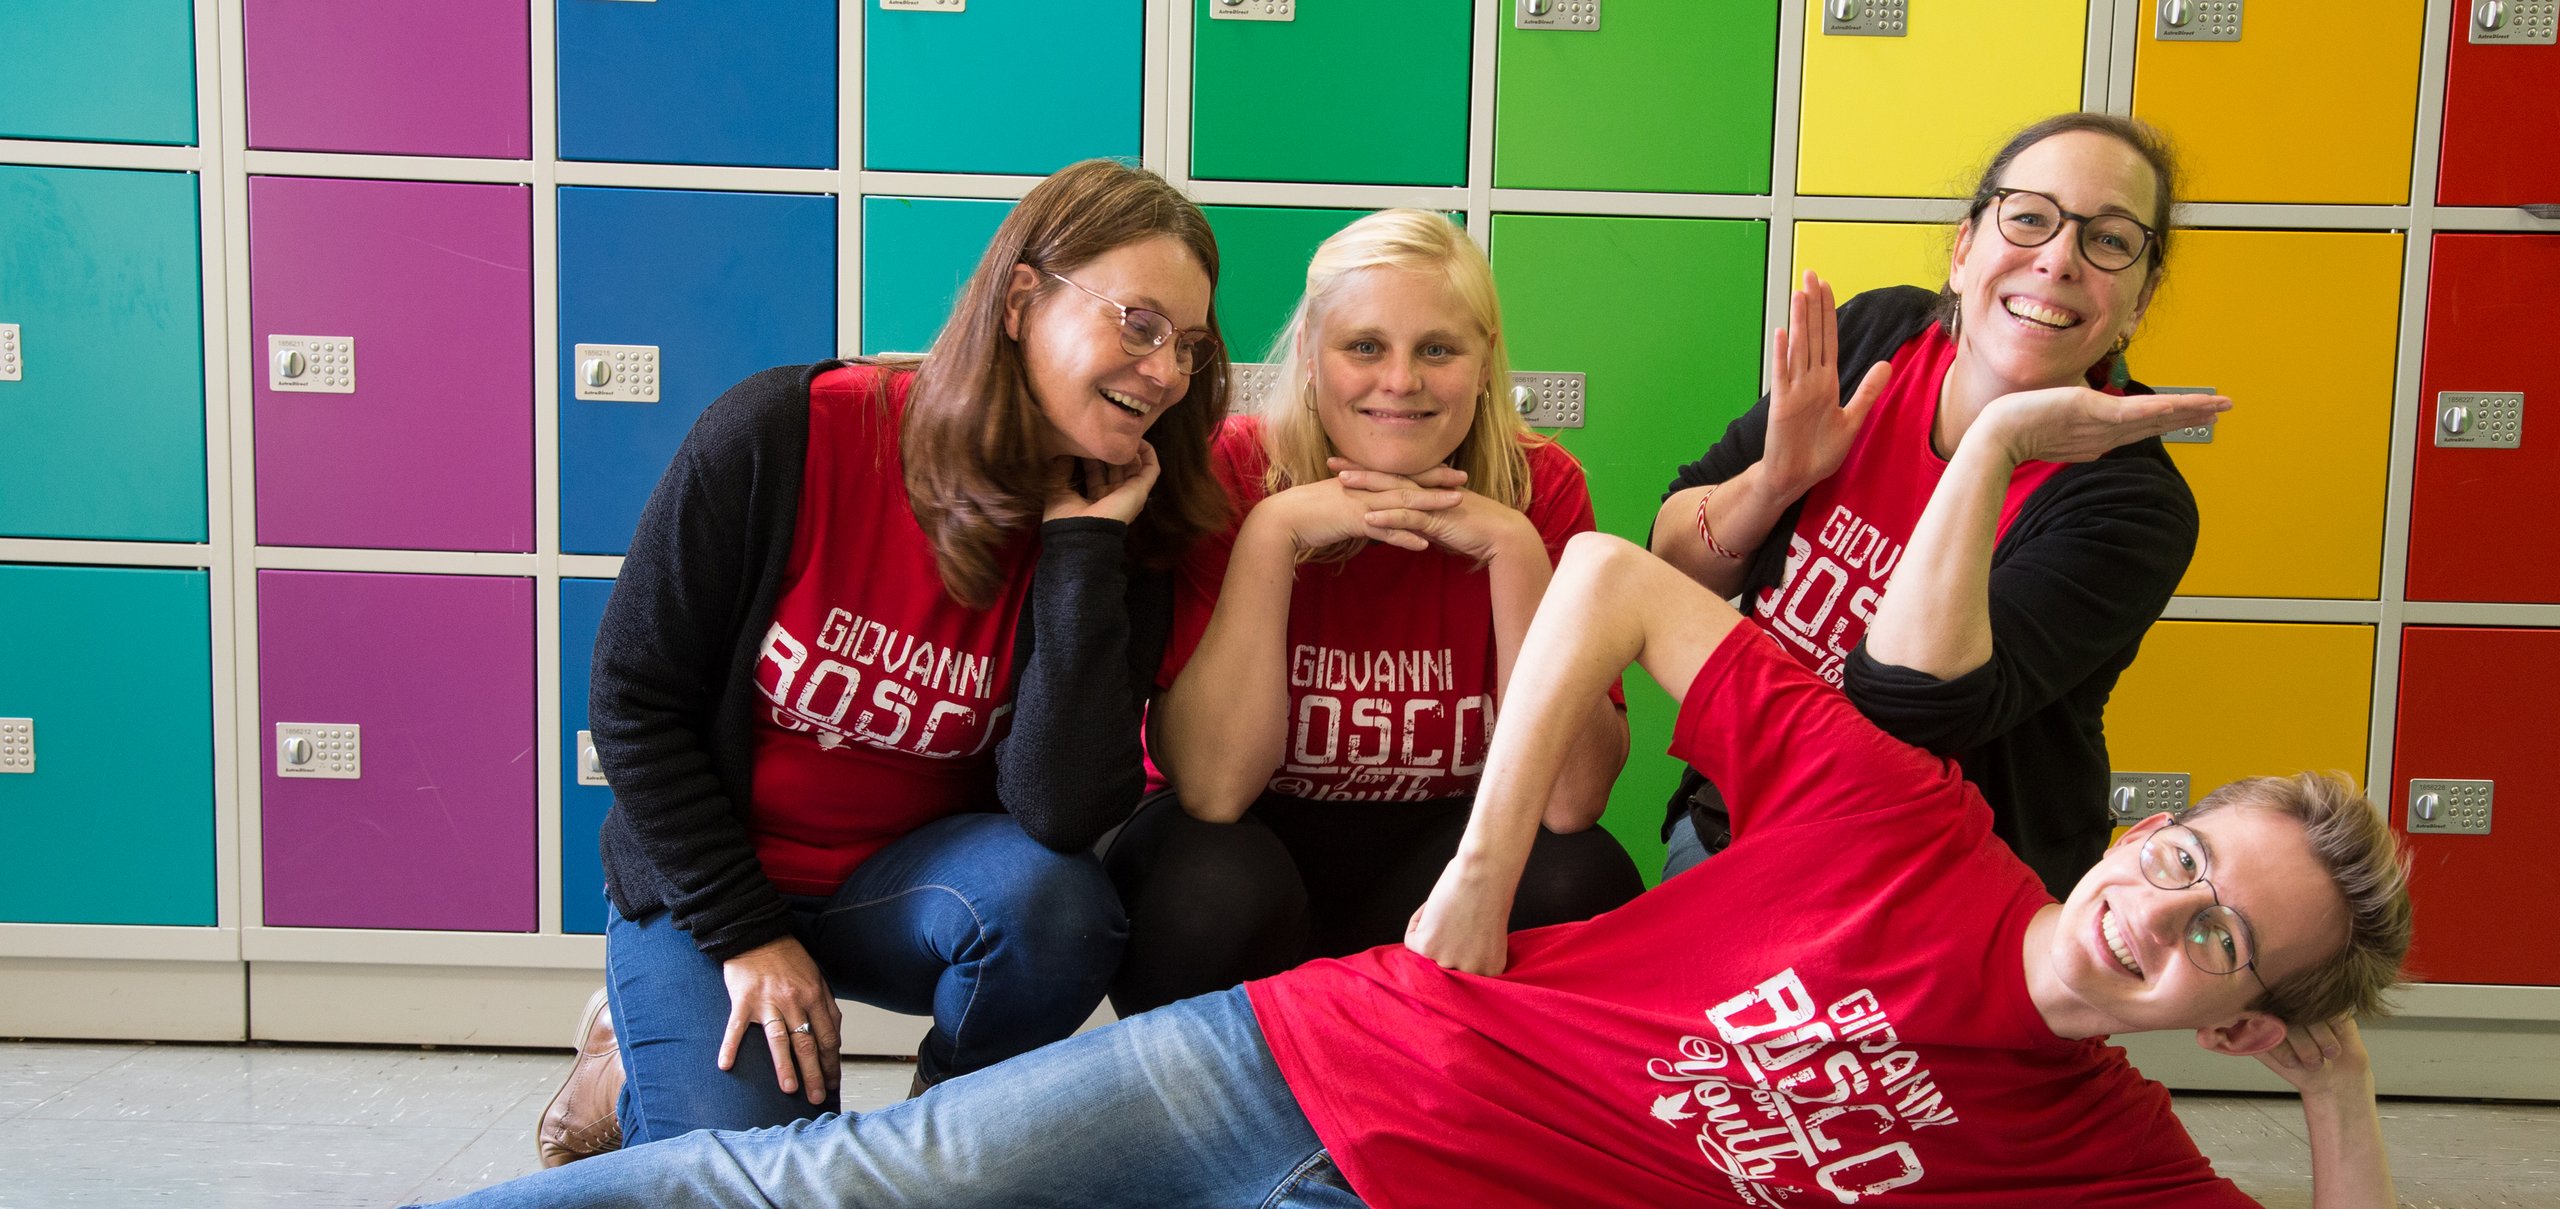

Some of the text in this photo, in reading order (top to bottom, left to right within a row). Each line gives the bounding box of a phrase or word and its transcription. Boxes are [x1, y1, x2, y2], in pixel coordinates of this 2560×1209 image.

[1818, 504, 1902, 590] GIOV
[1755, 532, 1884, 660] BOS
[816, 607, 995, 699] GIOVANNI
[1291, 644, 1453, 692] GIOVANNI
[1280, 693, 1495, 777] OSCO
[1705, 967, 1925, 1204] BOSCO
